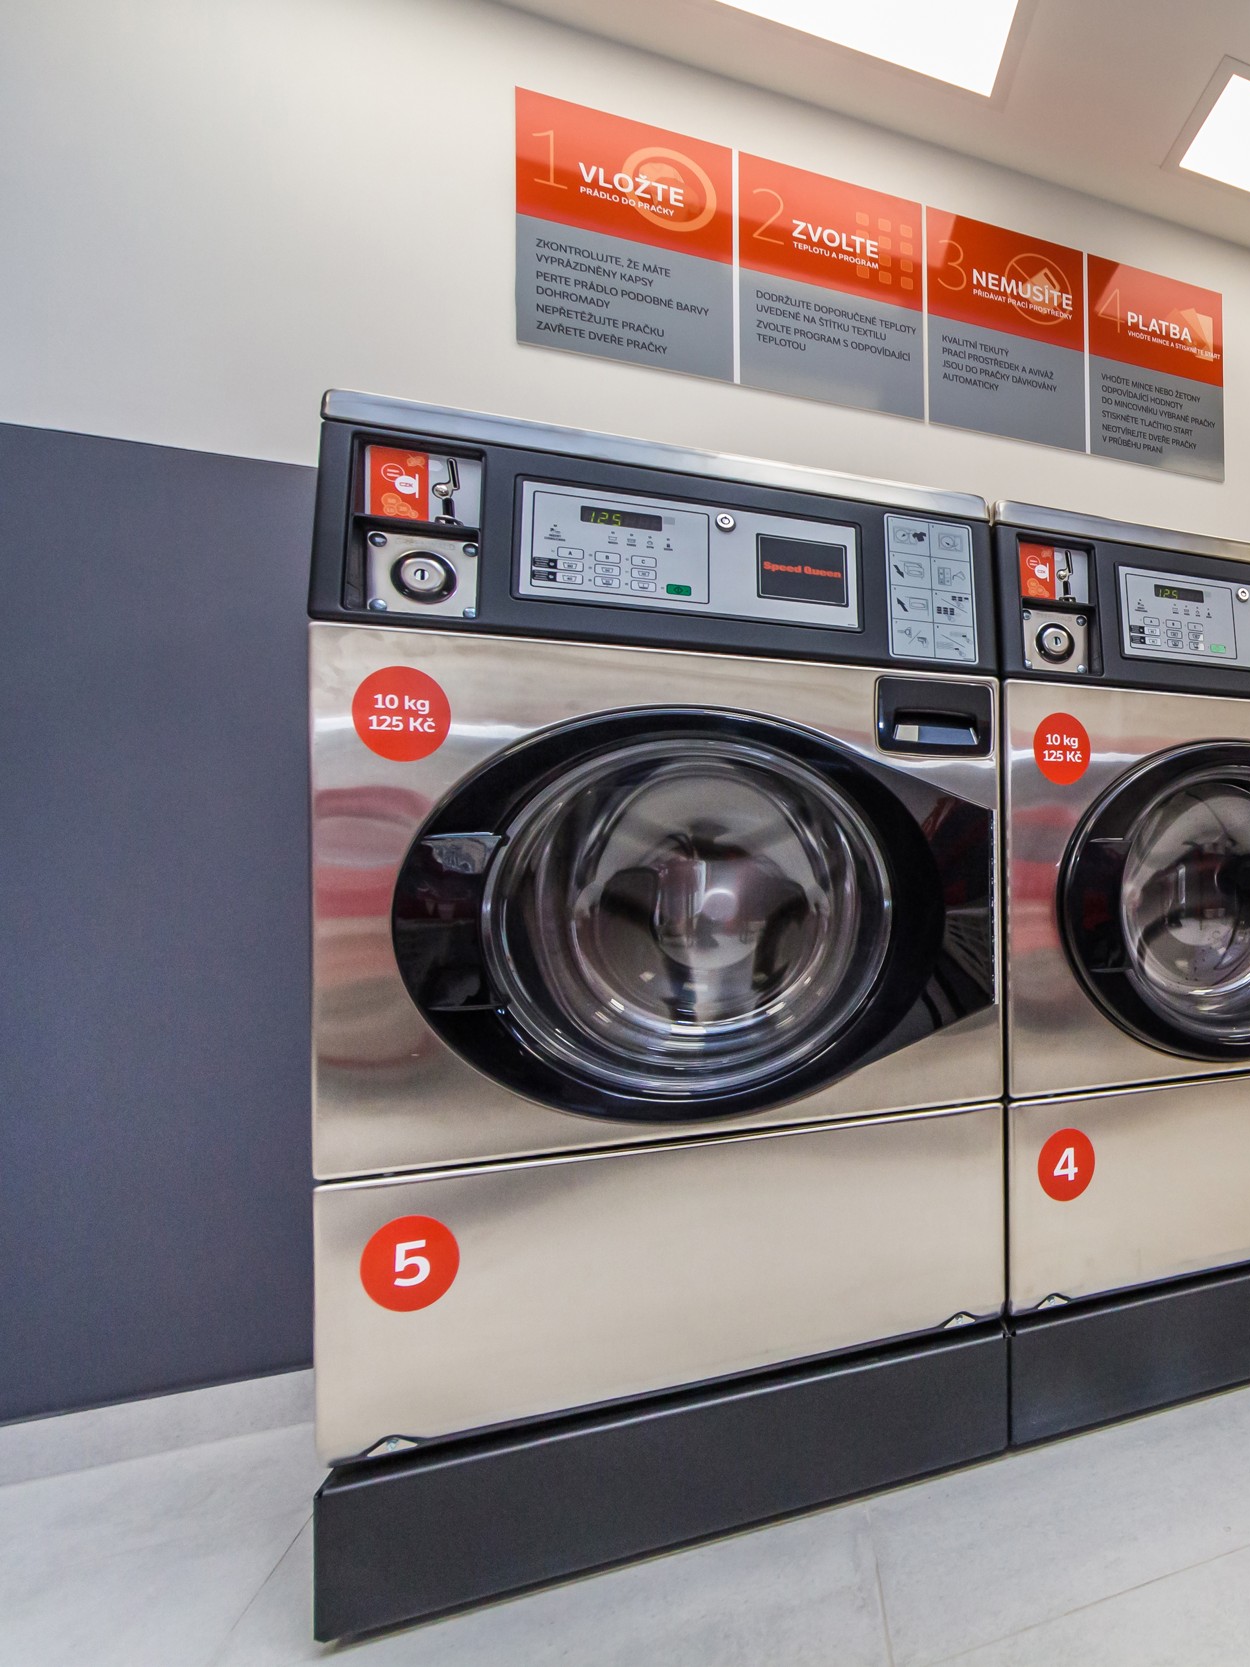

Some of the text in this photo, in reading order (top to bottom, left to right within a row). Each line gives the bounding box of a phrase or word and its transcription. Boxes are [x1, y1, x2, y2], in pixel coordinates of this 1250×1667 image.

[532, 130, 568, 190] 1
[578, 162, 685, 208] VLOŽTE
[580, 185, 675, 216] PRÁDLO DO PRAČKY
[752, 188, 784, 245] 2
[792, 219, 878, 258] ZVOLTE
[536, 238, 671, 277] ZKONTROLUJTE, ŽE MÁTE
[793, 241, 830, 257] TEPLOTU
[839, 253, 878, 269] PROGRAM
[938, 240, 966, 290] 3
[620, 272, 653, 287] KAPSY
[972, 268, 1073, 310] NEMUSÍTE
[536, 271, 709, 316] PERTE PRÁDLO PODOBNÉ BARVY
[536, 286, 610, 309] DOHROMADY
[756, 290, 812, 310] DODRŽUJTE
[880, 319, 916, 335] TEPLOTY
[756, 304, 801, 321] UVEDENÉ
[804, 315, 816, 324] NA
[852, 326, 887, 341] TEXTILU
[1098, 288, 1125, 333] 4
[536, 320, 667, 354] ZAVŘETE DVEŘE PRAČKY
[622, 320, 664, 337] PRAČKU
[756, 320, 791, 335] ZVOLTE
[794, 328, 841, 345] PROGRAM
[843, 339, 848, 347] S
[1128, 312, 1192, 343] PLATBA
[756, 333, 806, 351] TEPLOTOU
[942, 335, 977, 350] KVALITNÍ
[942, 347, 966, 359] PRACÍ
[968, 354, 1019, 372] PROSTŘEDEK
[1028, 368, 1054, 380] AVIVÁŽ
[942, 360, 963, 371] JSOU
[966, 366, 978, 374] DO
[980, 368, 1010, 381] PRAČKY
[943, 372, 999, 391] AUTOMATICKY
[1132, 381, 1200, 403] MINCE NEBO ŽETONY
[1102, 397, 1112, 405] DO
[1191, 417, 1215, 428] PRAČKY
[1150, 397, 1183, 409] HODNOTY
[1172, 439, 1196, 450] PRAČKY
[1174, 426, 1193, 436] START
[590, 511, 622, 527] 125
[763, 561, 842, 578] Speed Queen
[1158, 589, 1178, 599] 125
[374, 694, 430, 714] 10 kg
[368, 715, 436, 732] 125 Kč
[1046, 734, 1078, 749] 10 kg
[1043, 750, 1082, 762] 125 Kč
[1054, 1147, 1078, 1181] 4
[394, 1239, 430, 1287] 5
